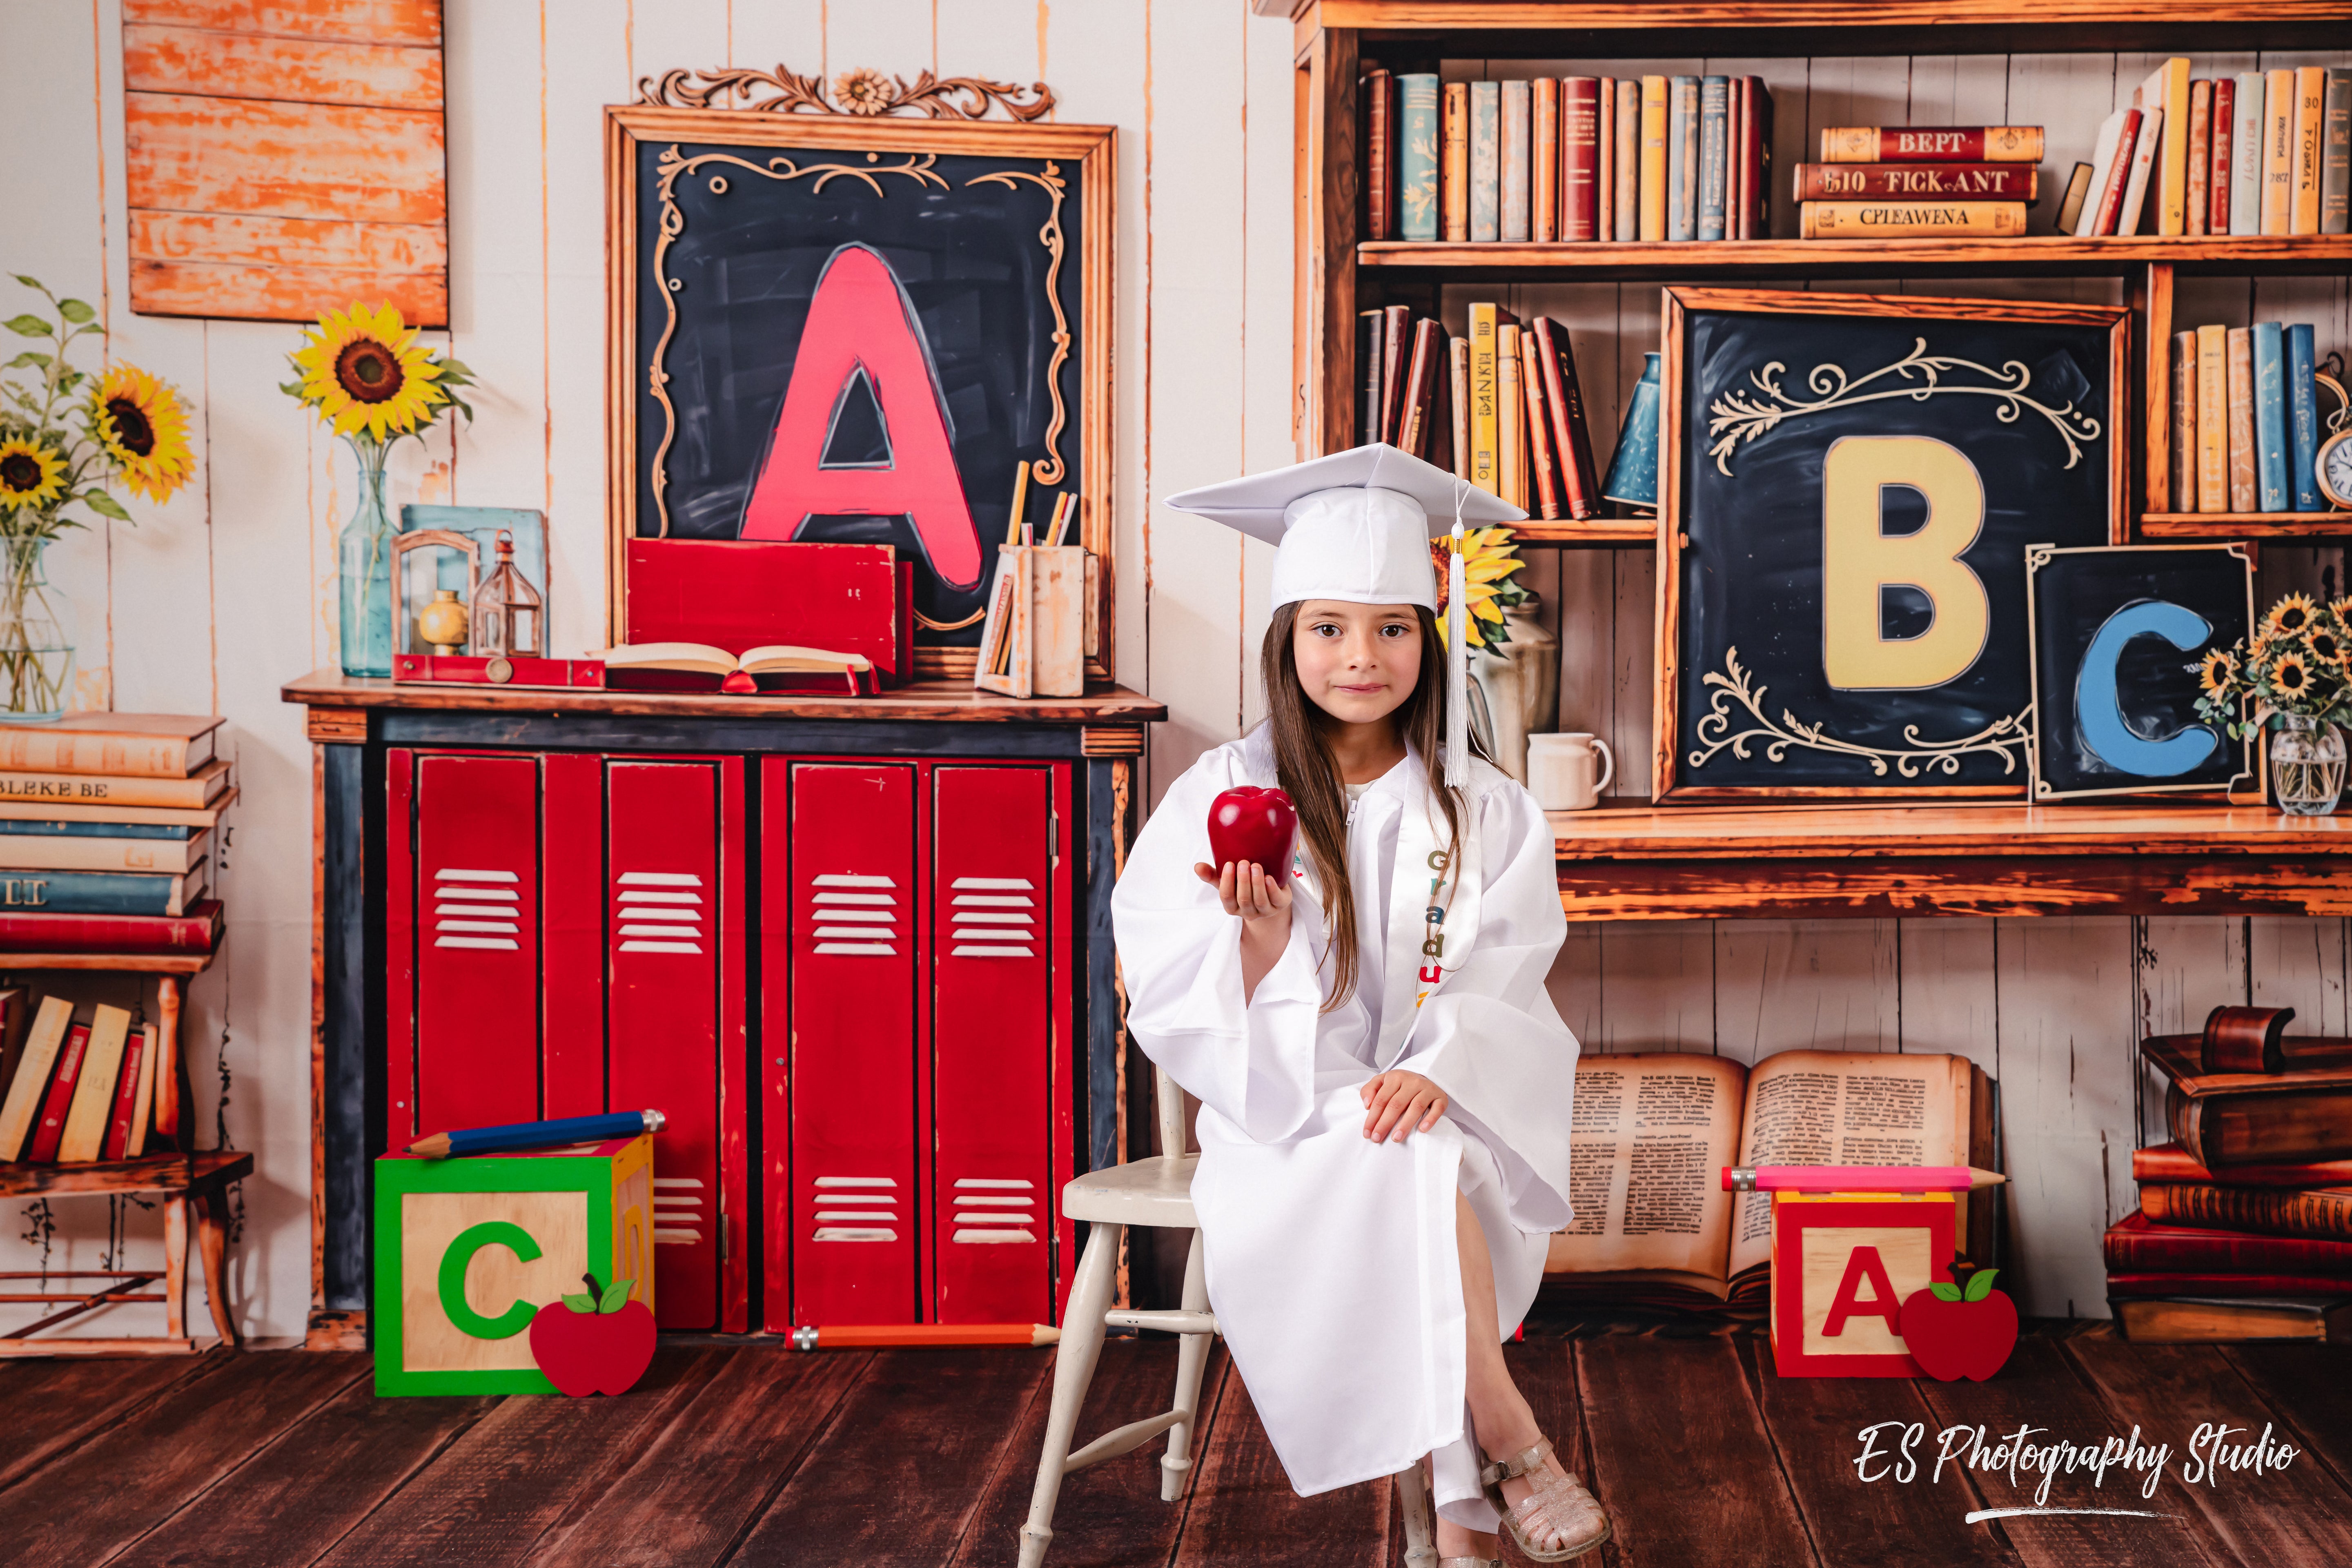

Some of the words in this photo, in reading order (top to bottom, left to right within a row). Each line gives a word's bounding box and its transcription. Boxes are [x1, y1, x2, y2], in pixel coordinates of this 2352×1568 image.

[737, 242, 983, 590] A
[1823, 436, 1990, 691] B
[2074, 599, 2217, 777] C
[438, 1221, 543, 1339] C
[1822, 1246, 1902, 1336] A
